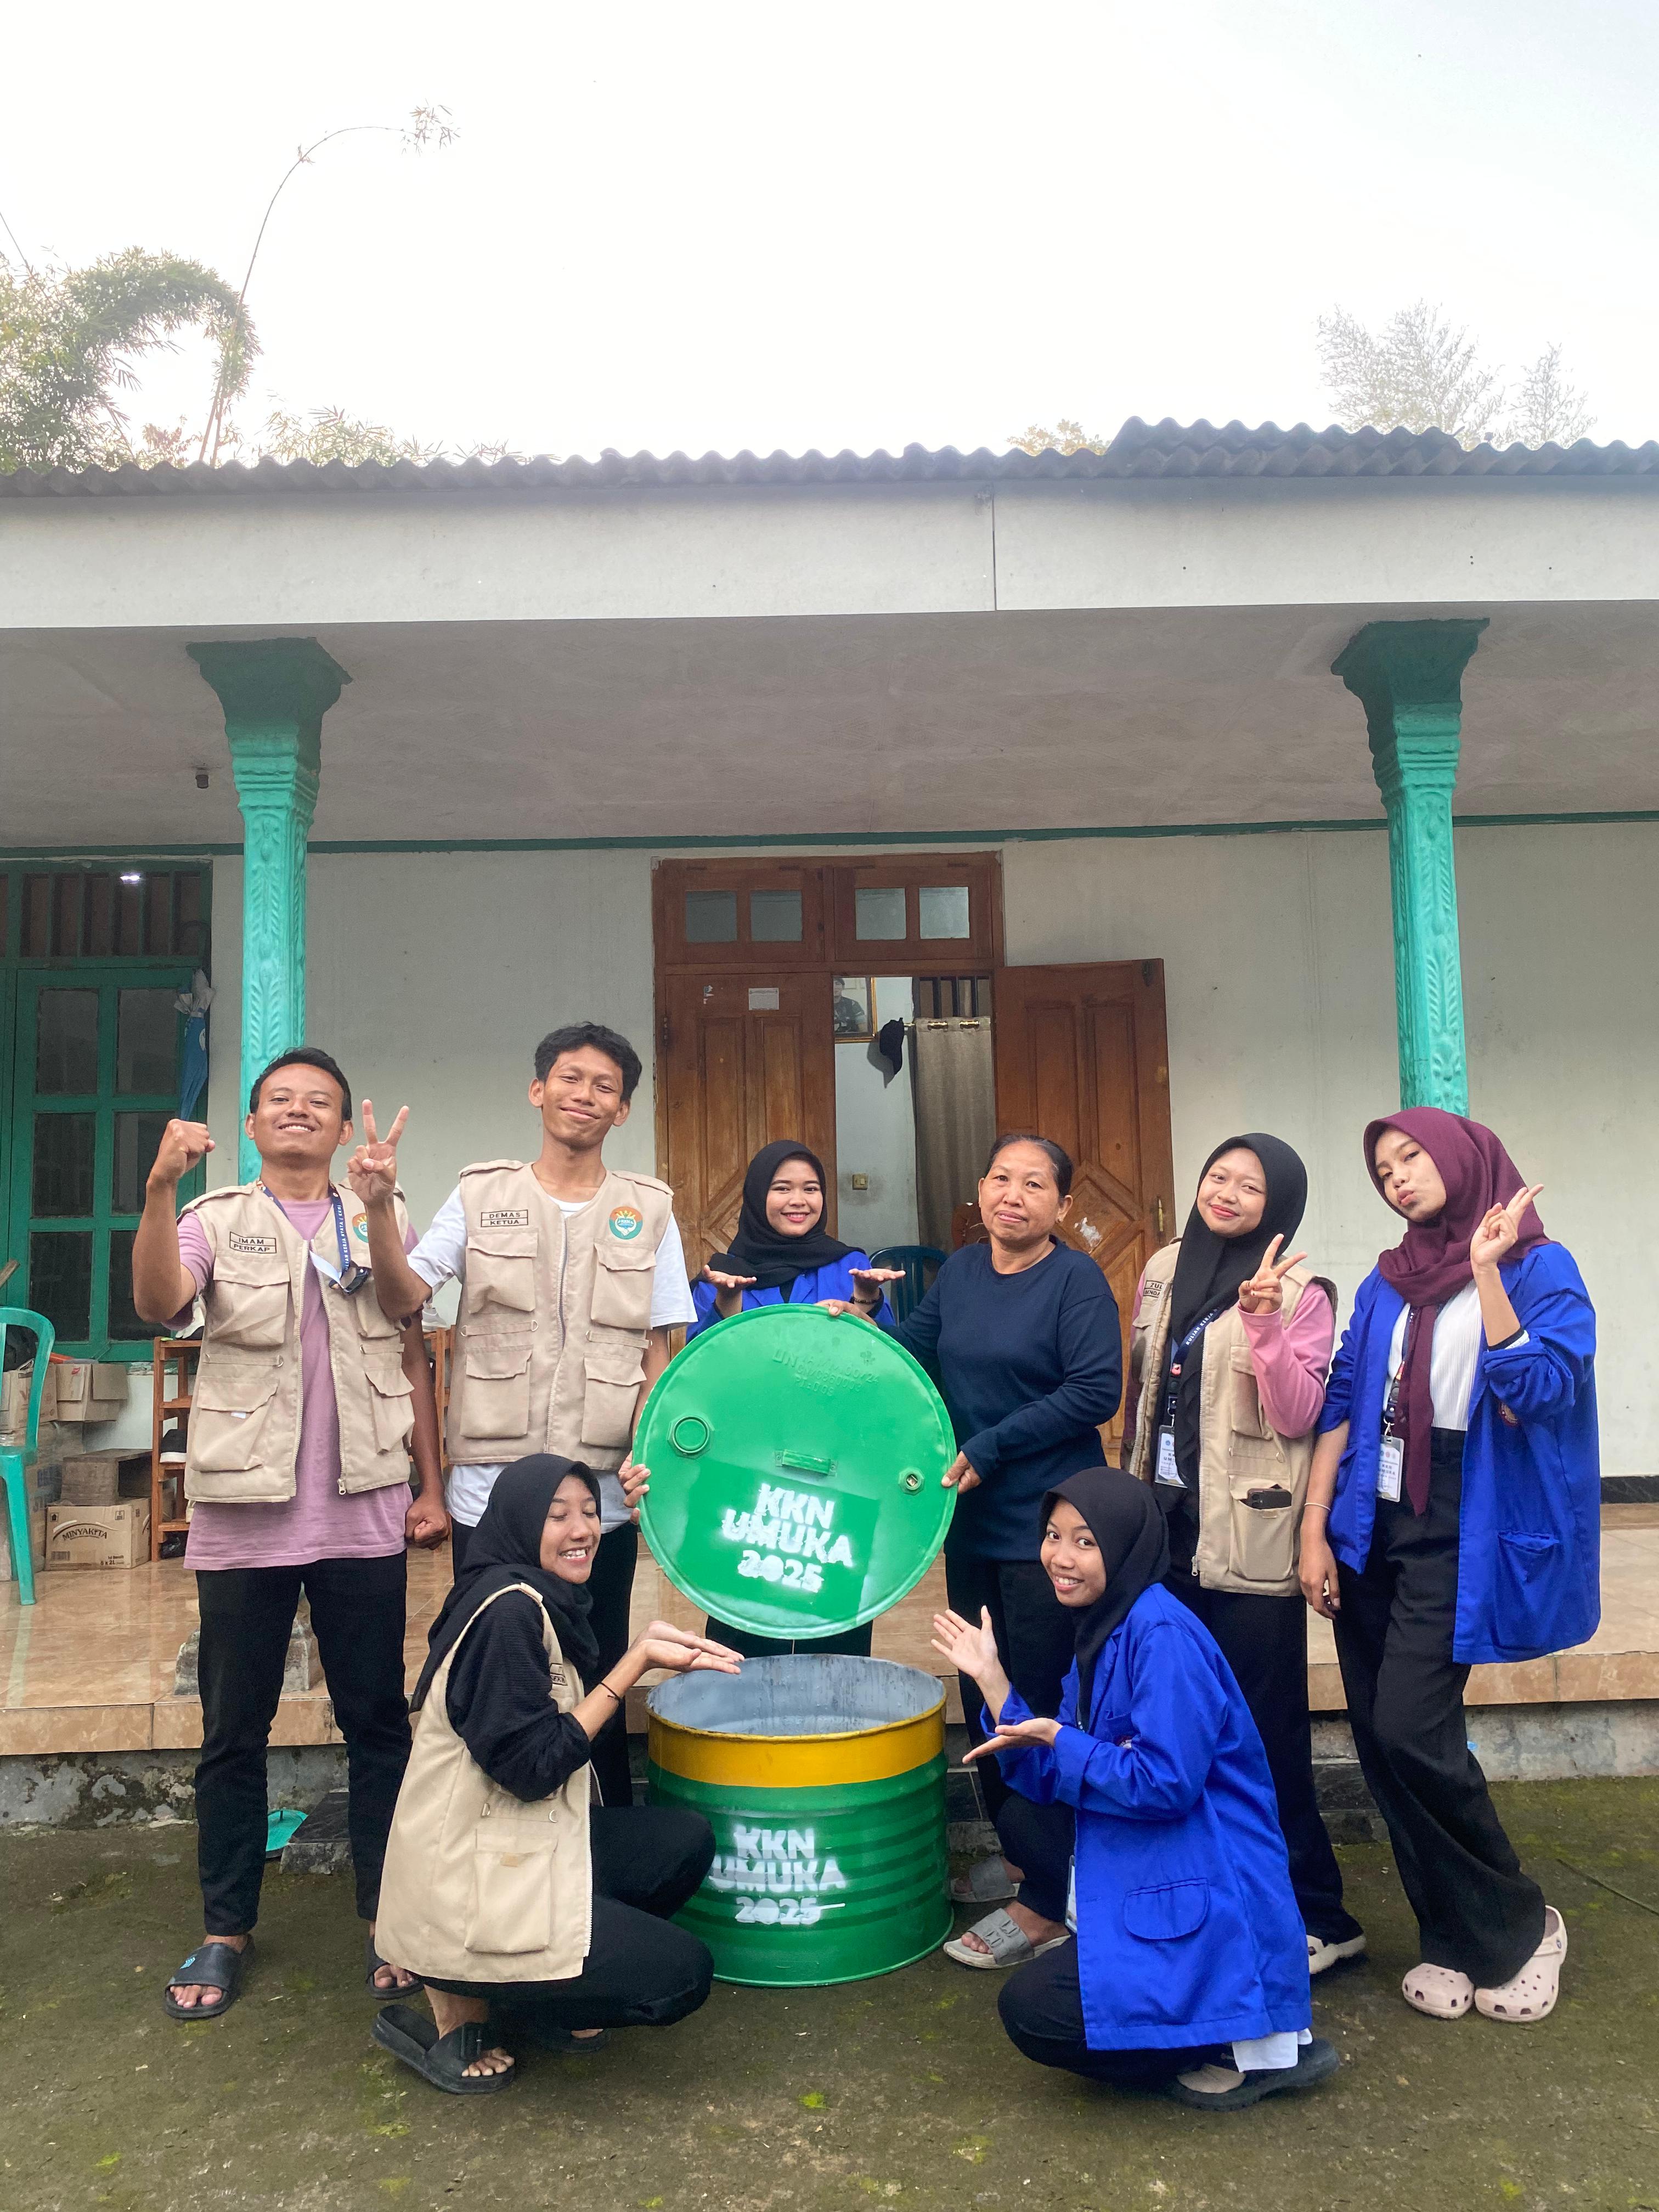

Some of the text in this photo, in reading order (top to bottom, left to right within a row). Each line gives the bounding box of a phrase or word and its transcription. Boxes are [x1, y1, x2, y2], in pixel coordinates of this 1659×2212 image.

[234, 1243, 270, 1252] PERKAP
[1185, 1312, 1214, 1346] KULIAH KERJA
[754, 1482, 835, 1530] KKN
[62, 1528, 108, 1541] MINYAKITA
[722, 1509, 854, 1567] UMUKA
[737, 1549, 824, 1593] 2025
[733, 1824, 815, 1860] KKN
[709, 1855, 847, 1893] UMUKA
[735, 1896, 823, 1925] 2025
